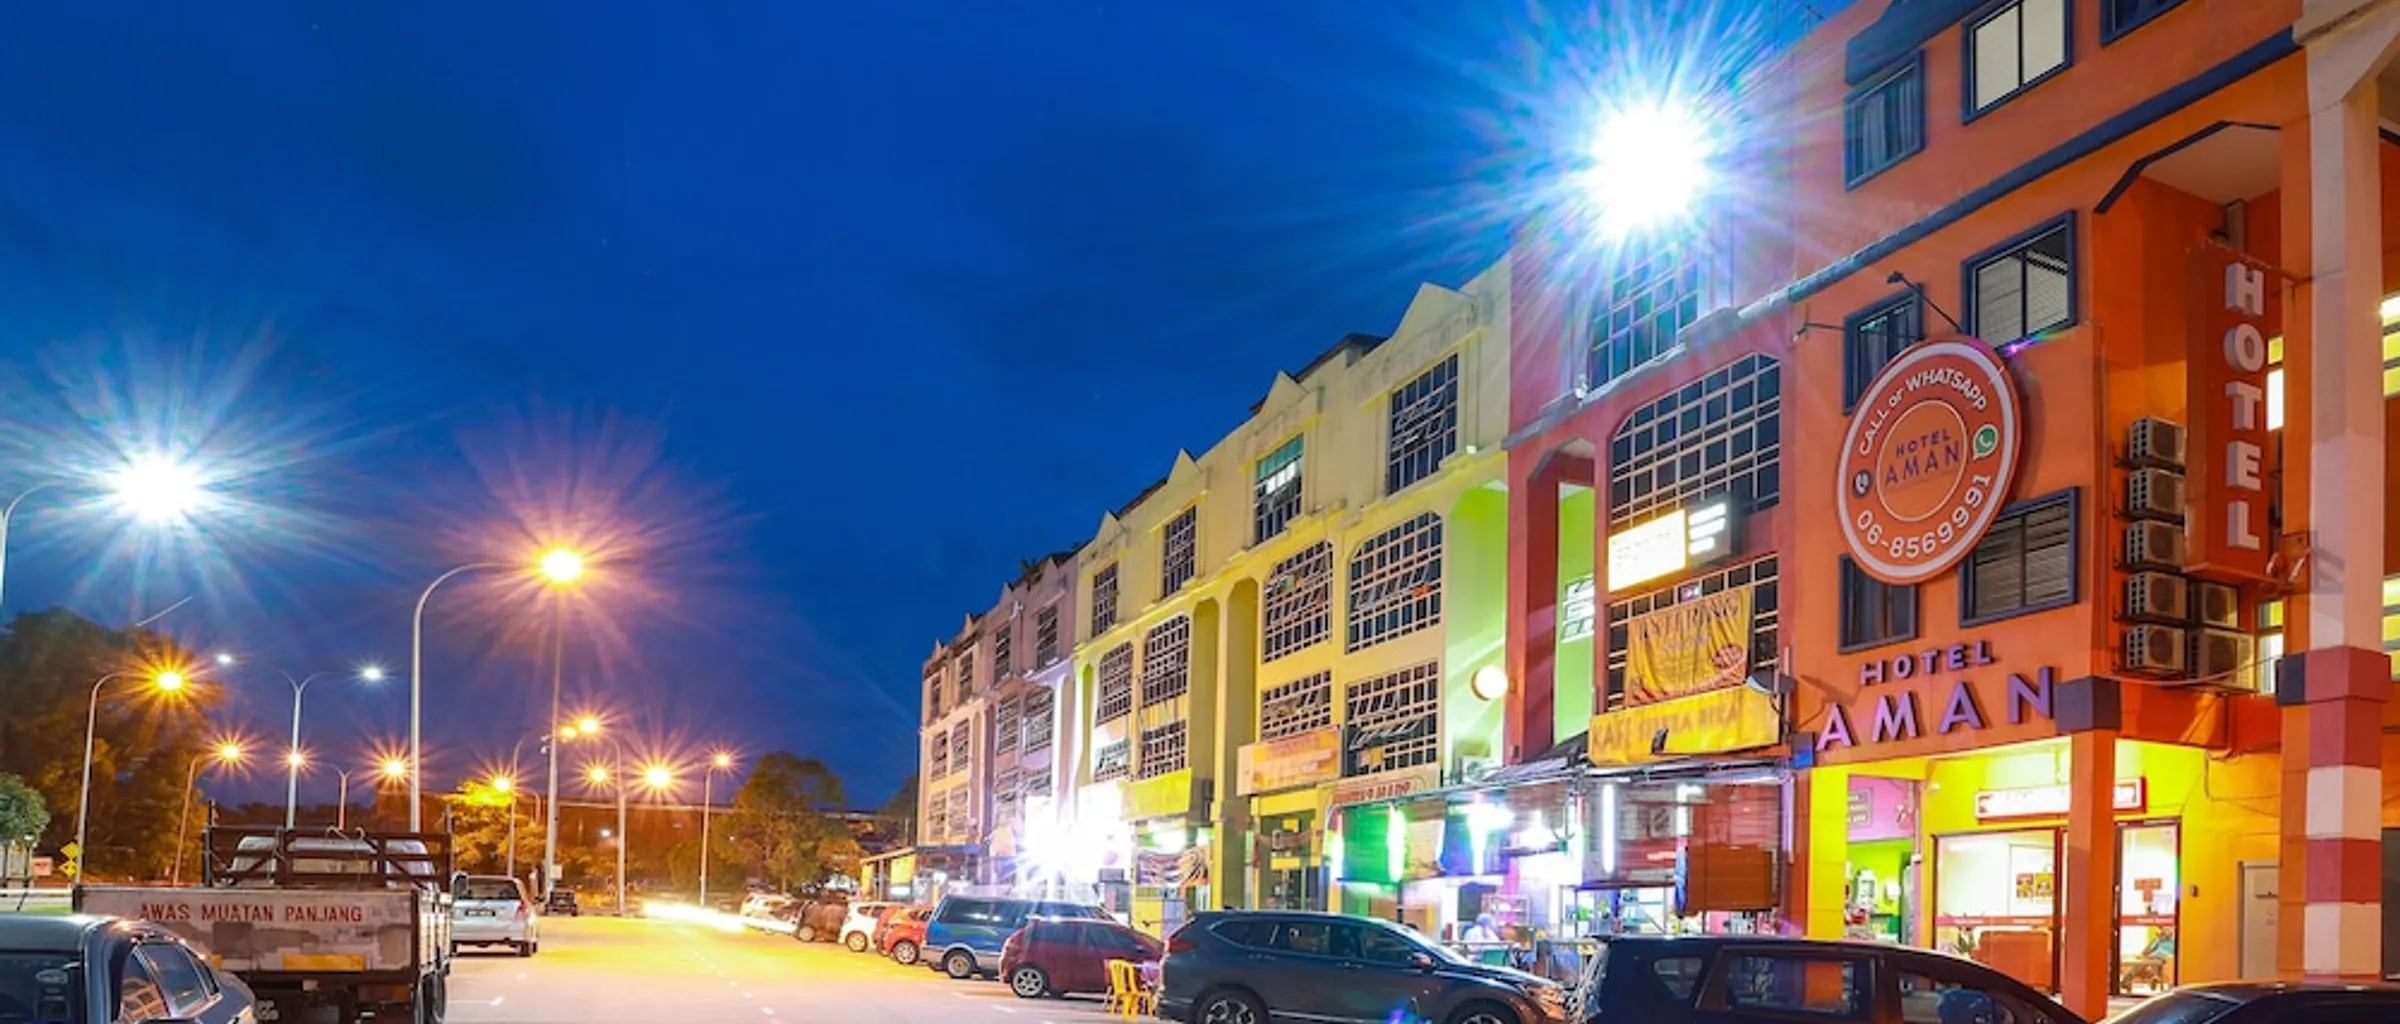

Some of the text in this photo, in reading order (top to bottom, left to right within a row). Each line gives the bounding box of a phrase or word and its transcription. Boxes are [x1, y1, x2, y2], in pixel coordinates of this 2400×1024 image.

[1860, 367, 1987, 455] CALL or WHATSAPP
[2224, 262, 2265, 550] HOTEL
[1885, 441, 1960, 487] AMAN
[1896, 429, 1951, 457] HOTEL
[1857, 473, 1991, 559] 06-8569991
[1859, 640, 1993, 687] HOTEL
[1815, 666, 2054, 751] AMAN
[139, 903, 363, 923] AWAS MUATAN PANJANG
